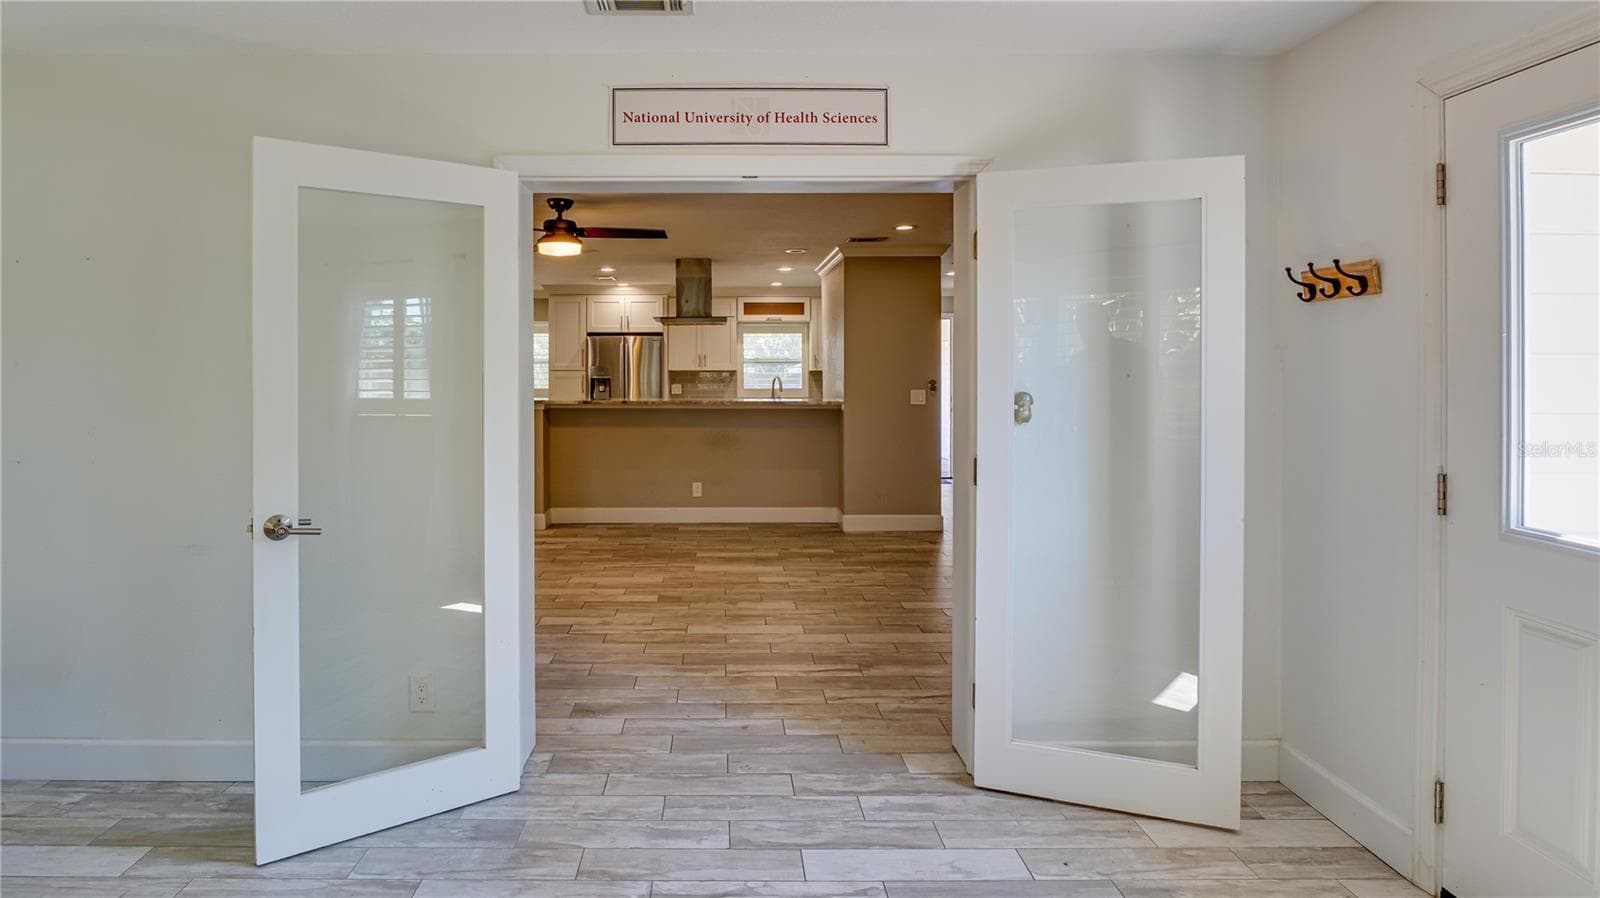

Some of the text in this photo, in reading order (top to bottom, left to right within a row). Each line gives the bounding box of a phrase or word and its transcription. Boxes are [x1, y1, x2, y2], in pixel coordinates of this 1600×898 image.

[622, 111, 878, 126] National University of Health Sciences
